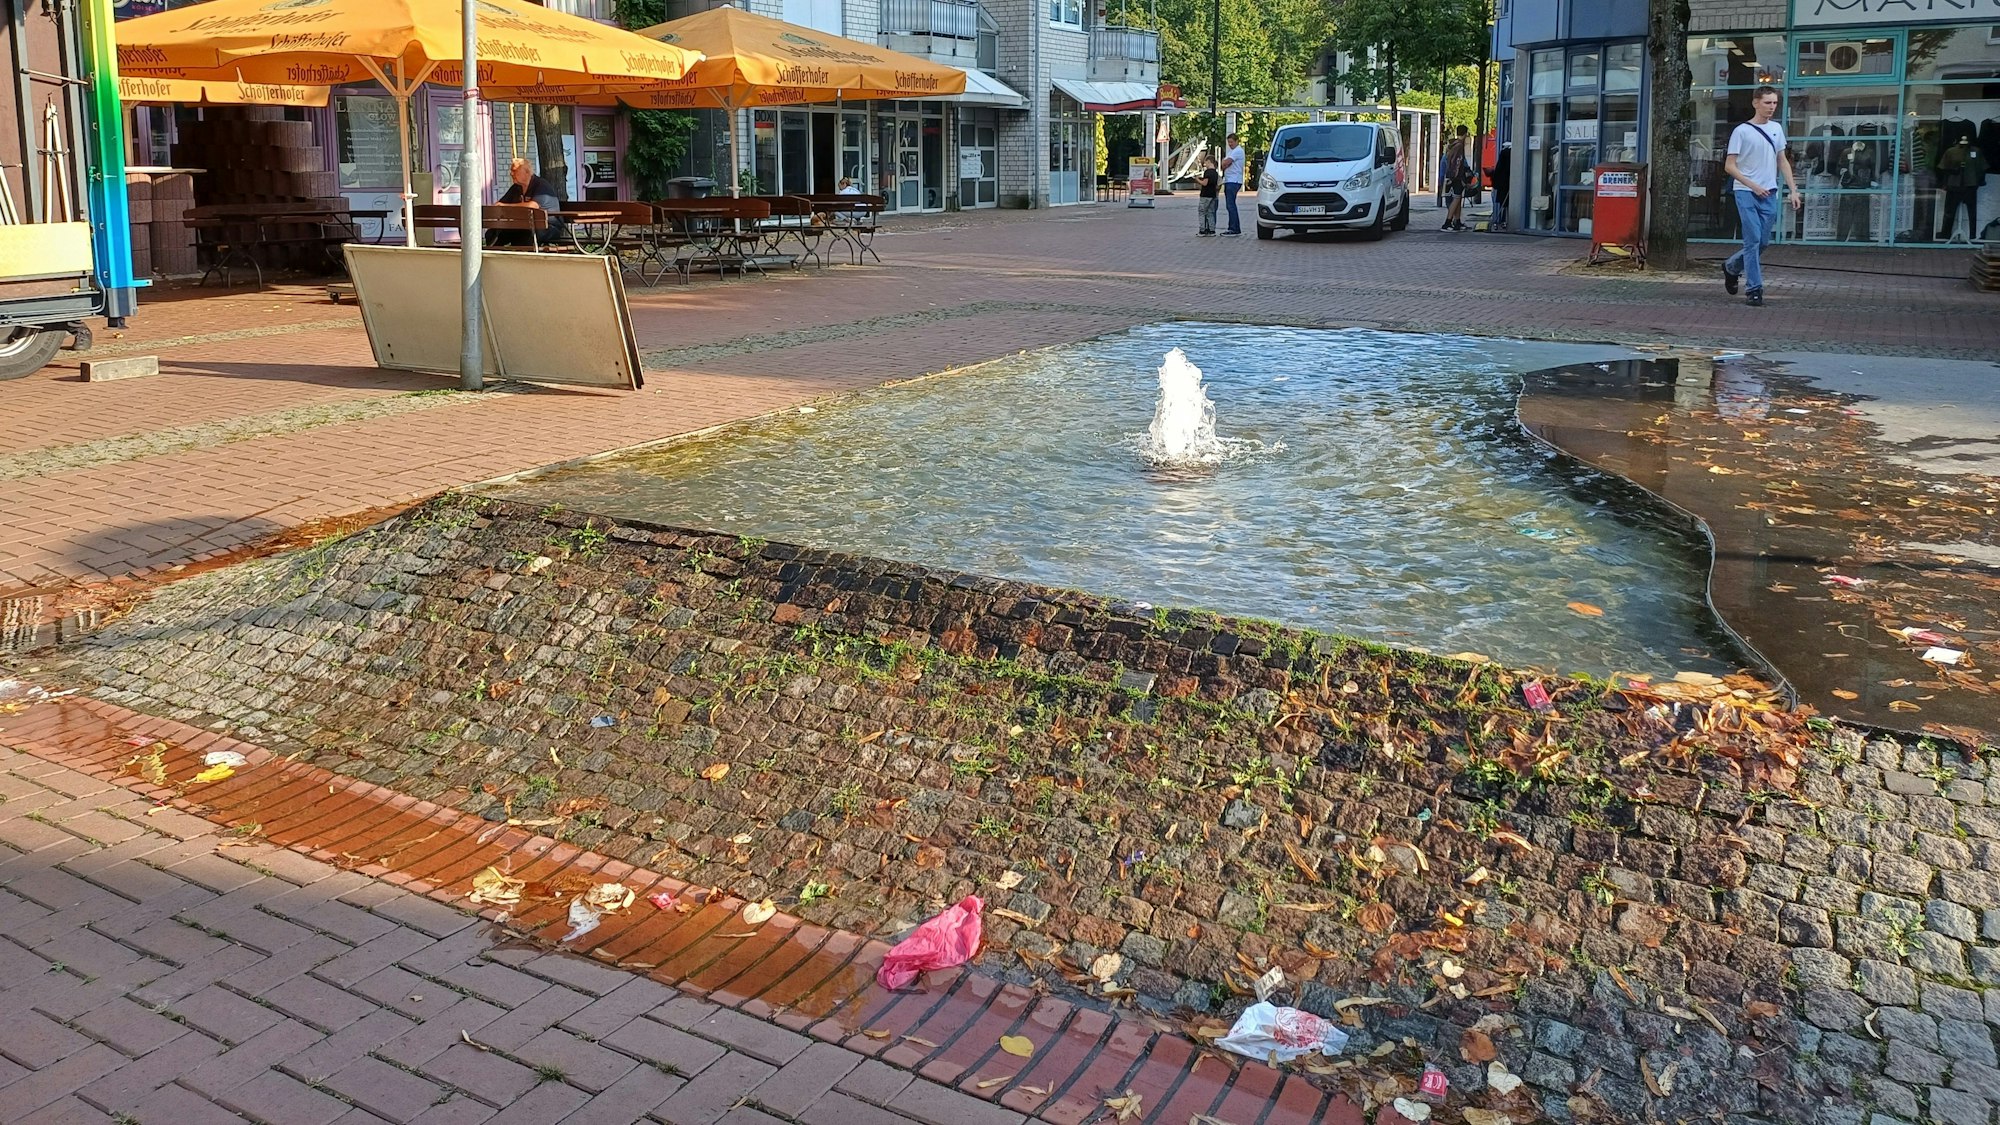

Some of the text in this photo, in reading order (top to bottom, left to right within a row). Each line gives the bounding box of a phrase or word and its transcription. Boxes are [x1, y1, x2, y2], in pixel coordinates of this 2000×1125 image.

[261, 31, 351, 53] Schöfferhofer
[620, 50, 675, 75] Schöfferhofer
[775, 62, 829, 85] Schöfferhofer
[894, 69, 940, 91] Schöfferhofer
[237, 81, 305, 102] Schöfferhofer
[389, 223, 405, 232] FA
